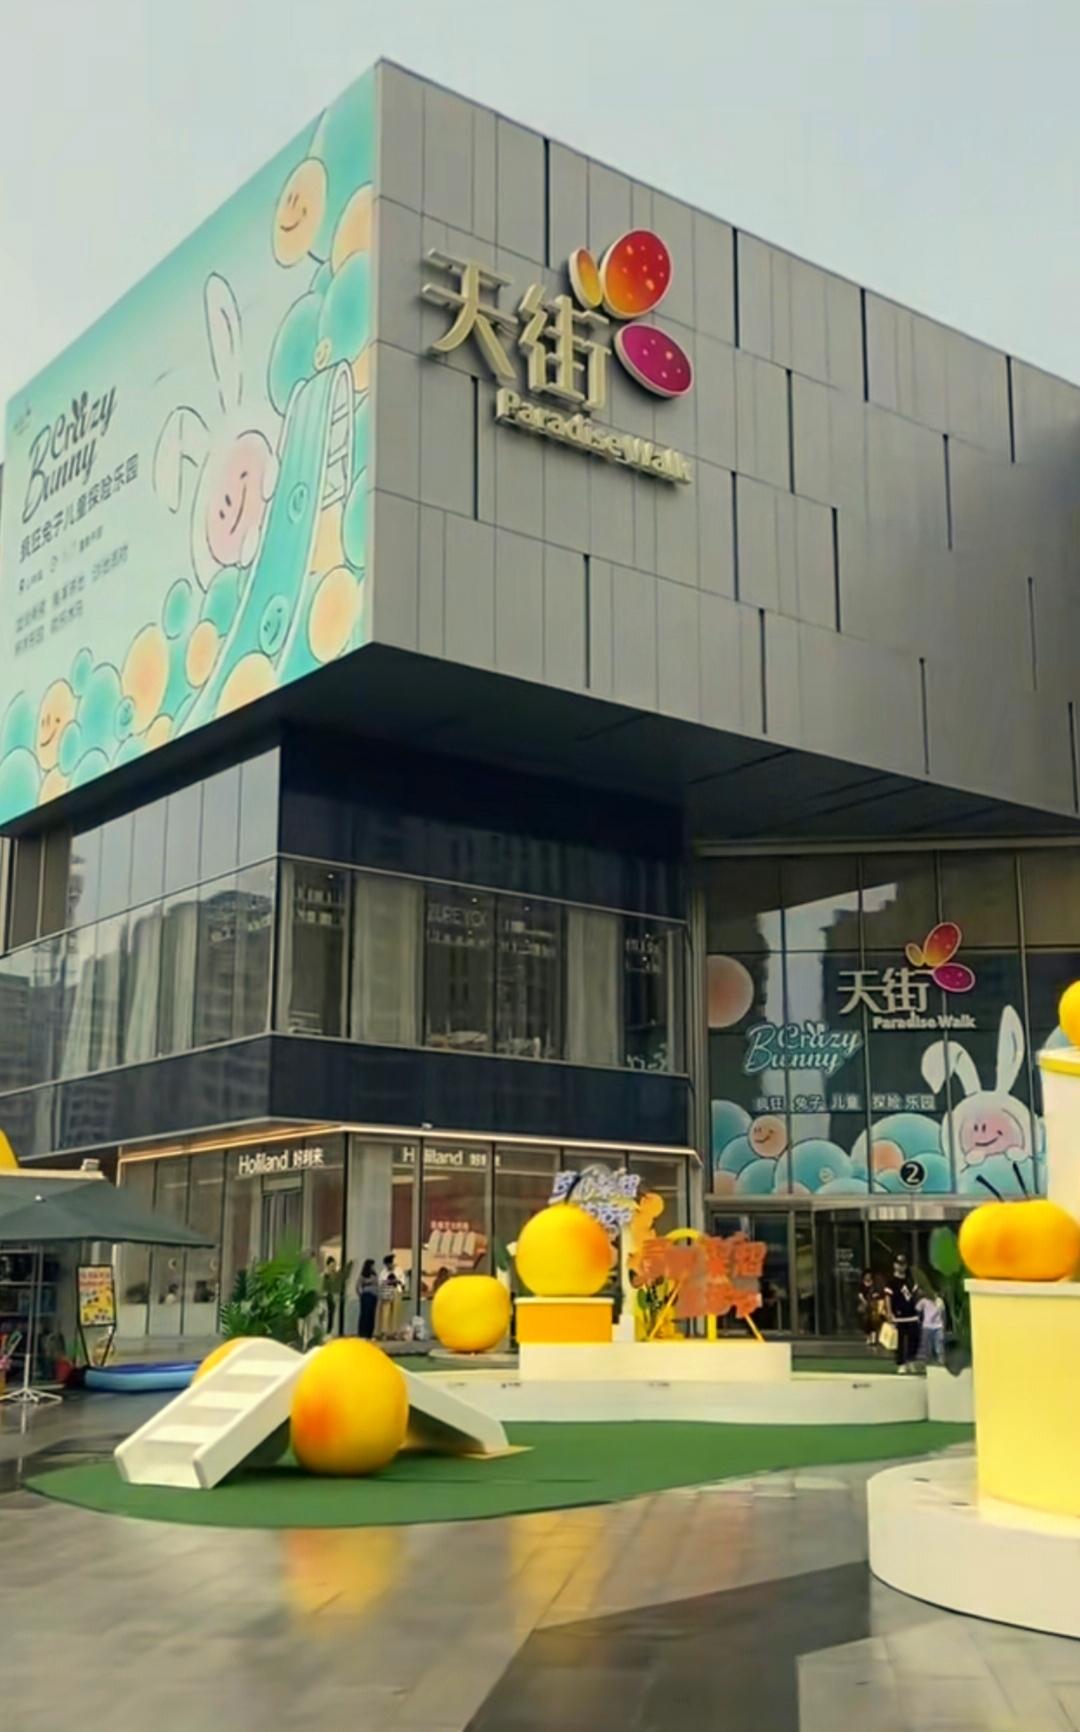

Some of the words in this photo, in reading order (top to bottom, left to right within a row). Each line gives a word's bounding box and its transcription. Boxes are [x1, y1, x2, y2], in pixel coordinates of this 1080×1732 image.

[421, 247, 612, 411] 天街
[496, 387, 622, 459] Paradise
[837, 967, 931, 1015] 天街
[873, 1011, 937, 1030] Paradise
[937, 1014, 976, 1030] Walk
[906, 1163, 919, 1183] 2
